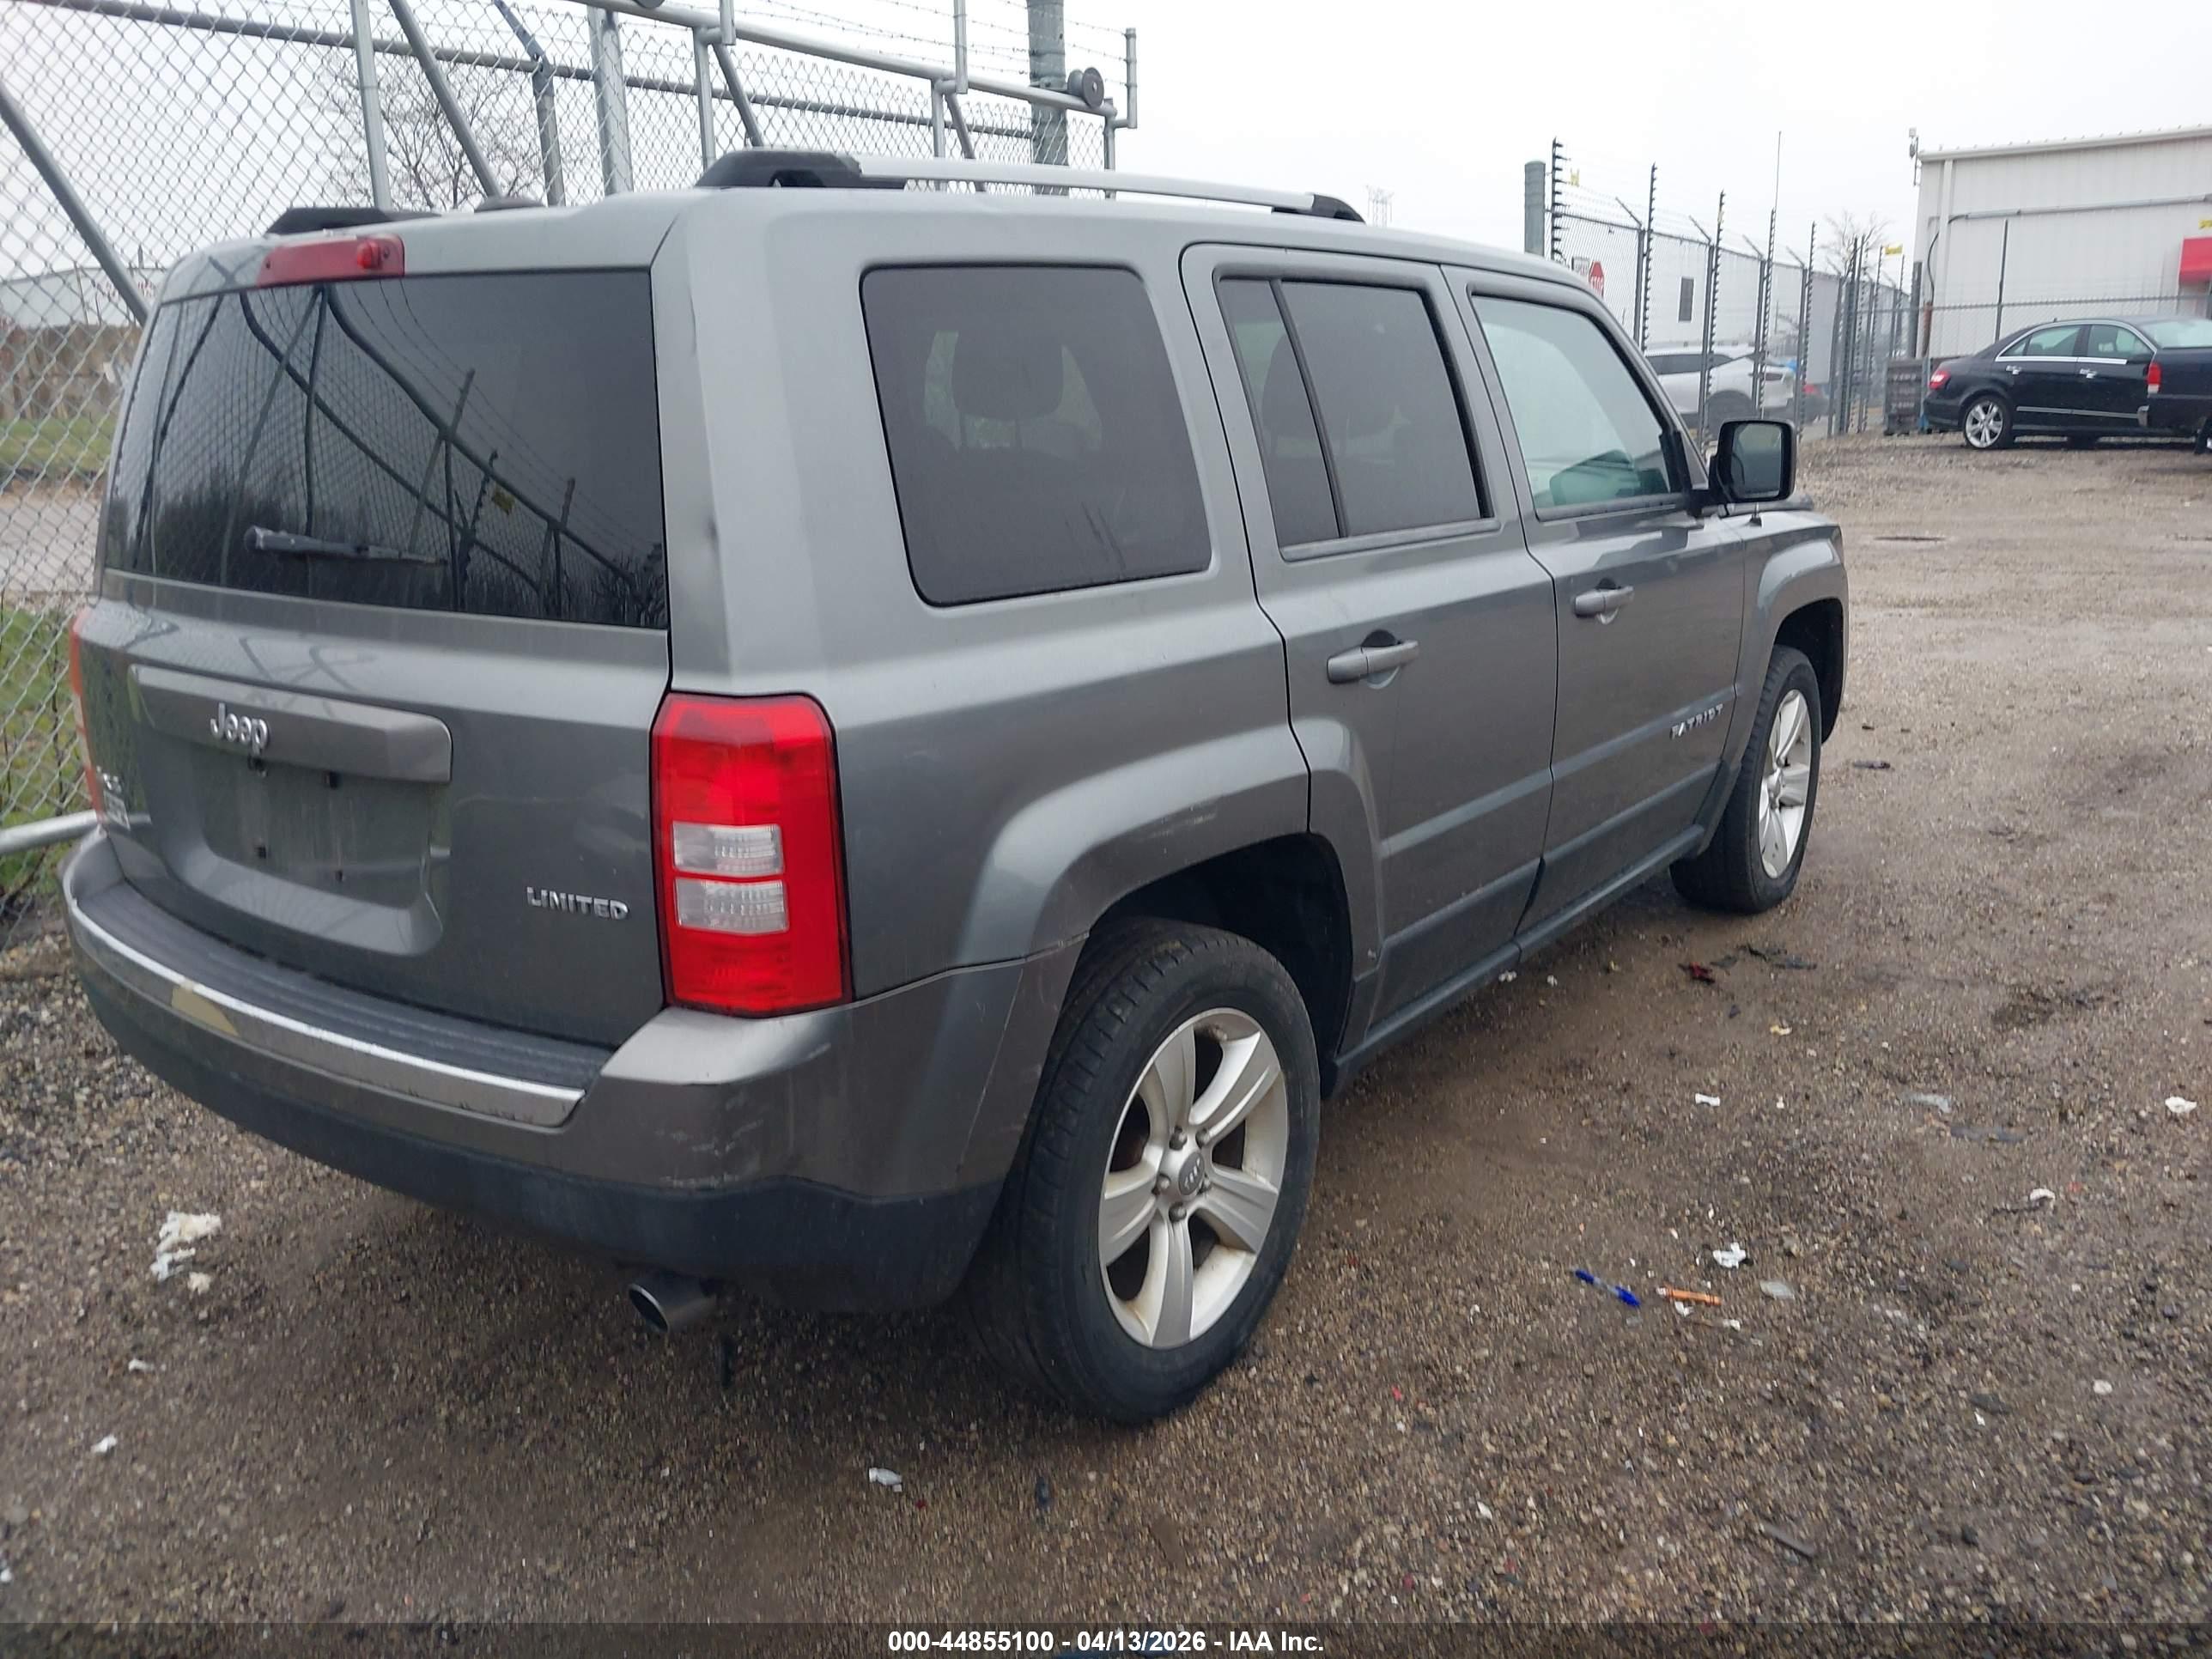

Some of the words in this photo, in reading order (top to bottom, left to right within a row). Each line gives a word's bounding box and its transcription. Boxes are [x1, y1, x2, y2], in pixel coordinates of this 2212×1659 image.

[210, 702, 269, 754] Jeep
[1670, 703, 1724, 739] PATRIOT
[526, 886, 629, 921] LIMITED
